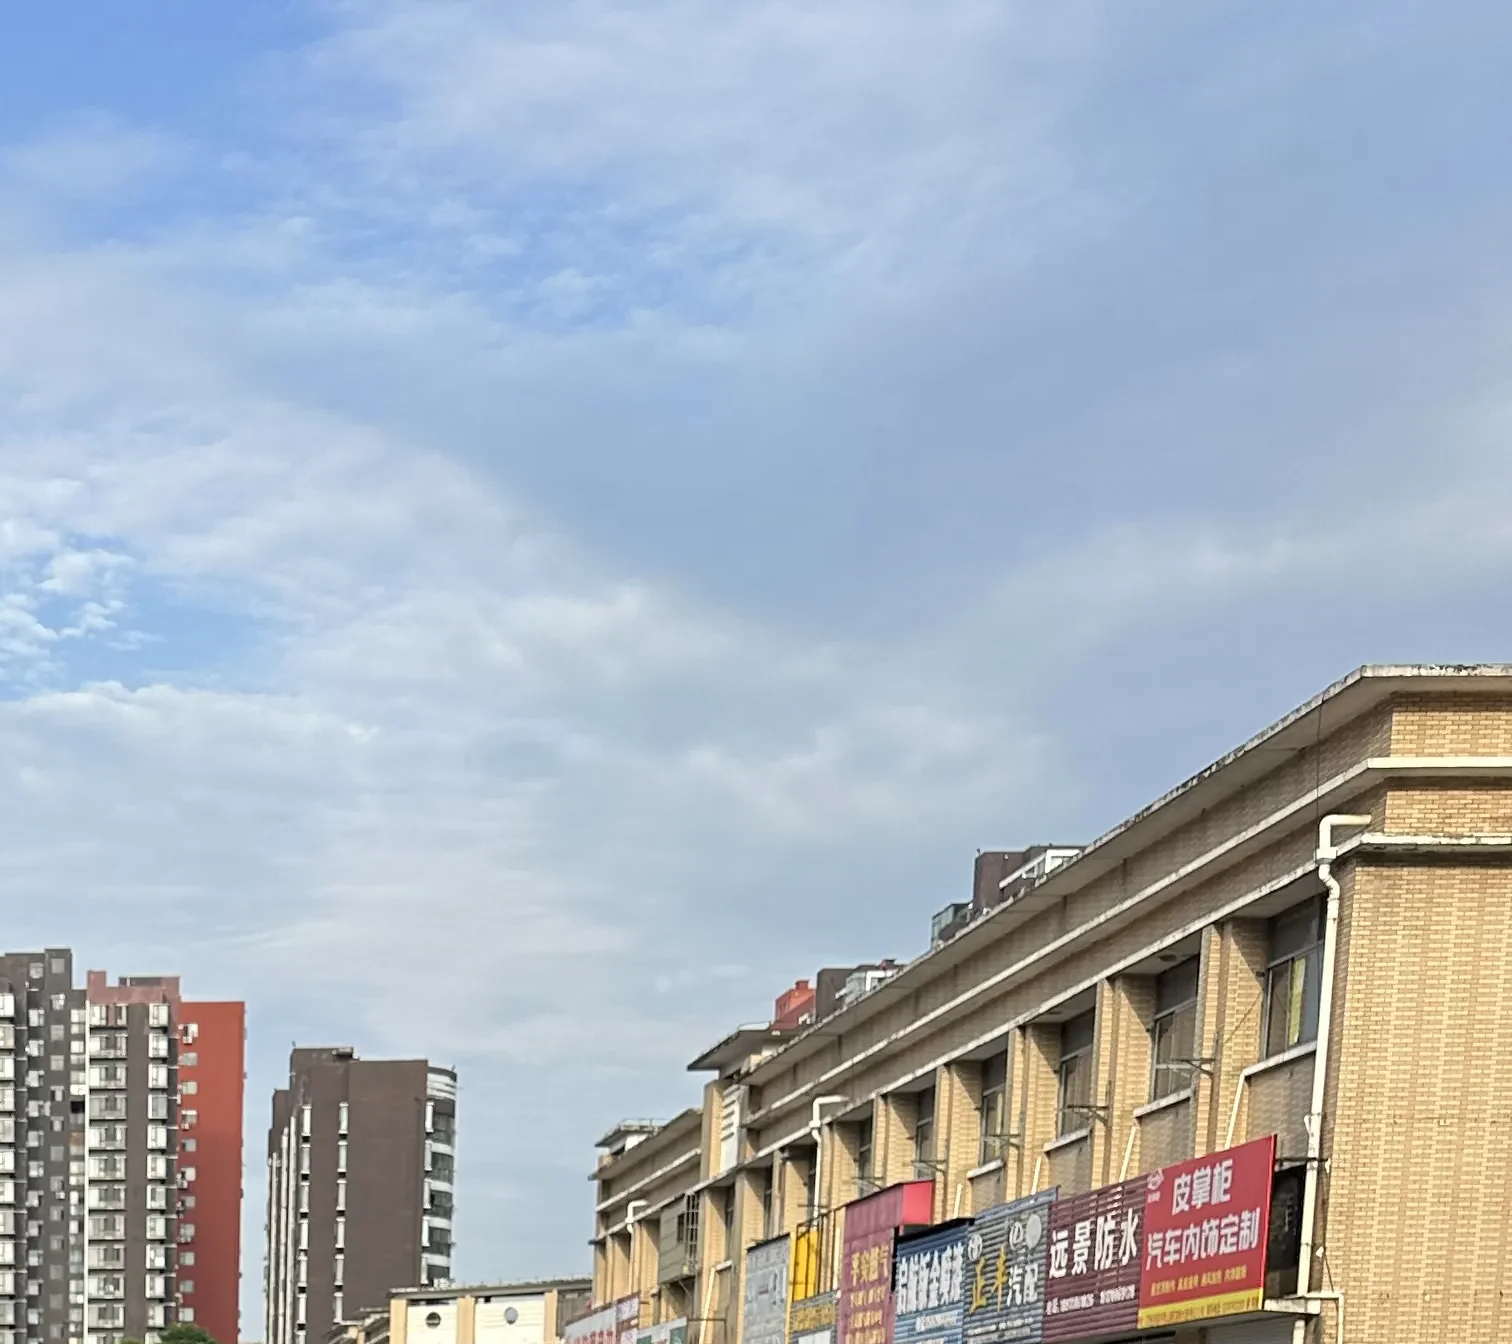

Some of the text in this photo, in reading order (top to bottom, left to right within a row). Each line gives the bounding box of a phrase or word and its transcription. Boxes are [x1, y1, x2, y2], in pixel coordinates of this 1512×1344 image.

[1172, 1158, 1233, 1215] 皮掌柜
[1049, 1207, 1138, 1279] 远景防水
[1146, 1206, 1260, 1271] 汽车内饰定制
